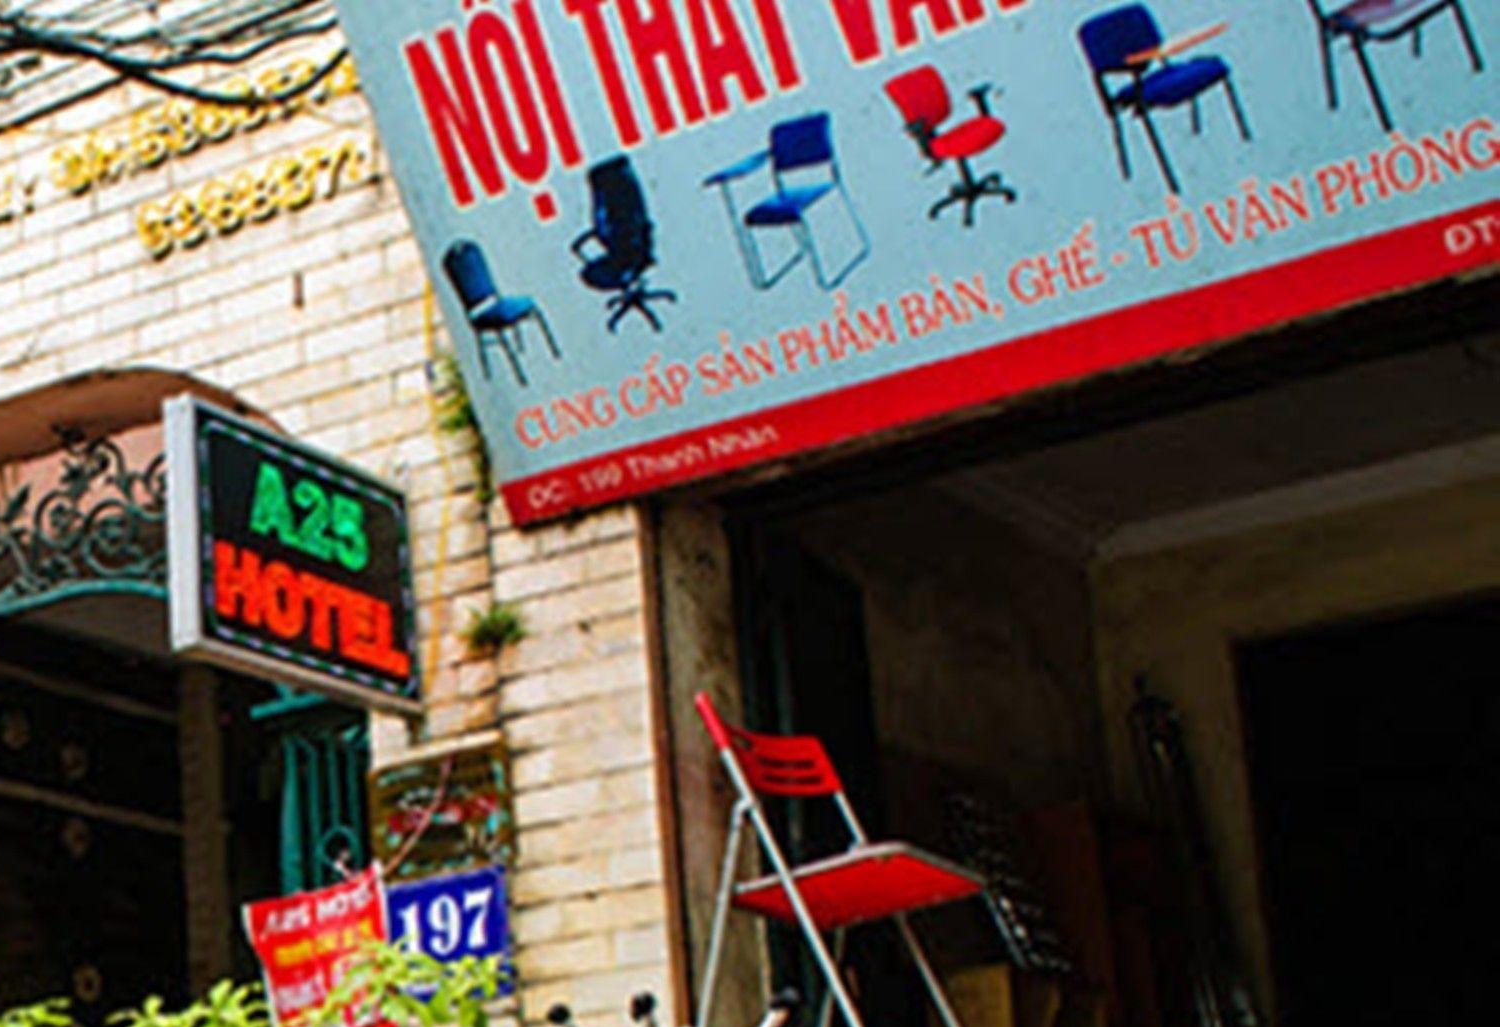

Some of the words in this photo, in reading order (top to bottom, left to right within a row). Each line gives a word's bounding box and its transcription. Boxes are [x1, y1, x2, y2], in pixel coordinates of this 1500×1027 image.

[514, 385, 618, 450] CUNG
[618, 351, 691, 418] CẤP
[696, 330, 775, 397] SẢN
[777, 292, 898, 372] PHẨM
[1007, 220, 1105, 304] GHẾ
[1129, 193, 1199, 269] TỦ
[1204, 176, 1311, 246] VĂN
[1314, 117, 1500, 217] PHÒNG
[625, 442, 705, 479] Thanh
[249, 462, 368, 572] A25
[213, 538, 410, 678] HOTEL
[398, 886, 493, 956] 197
